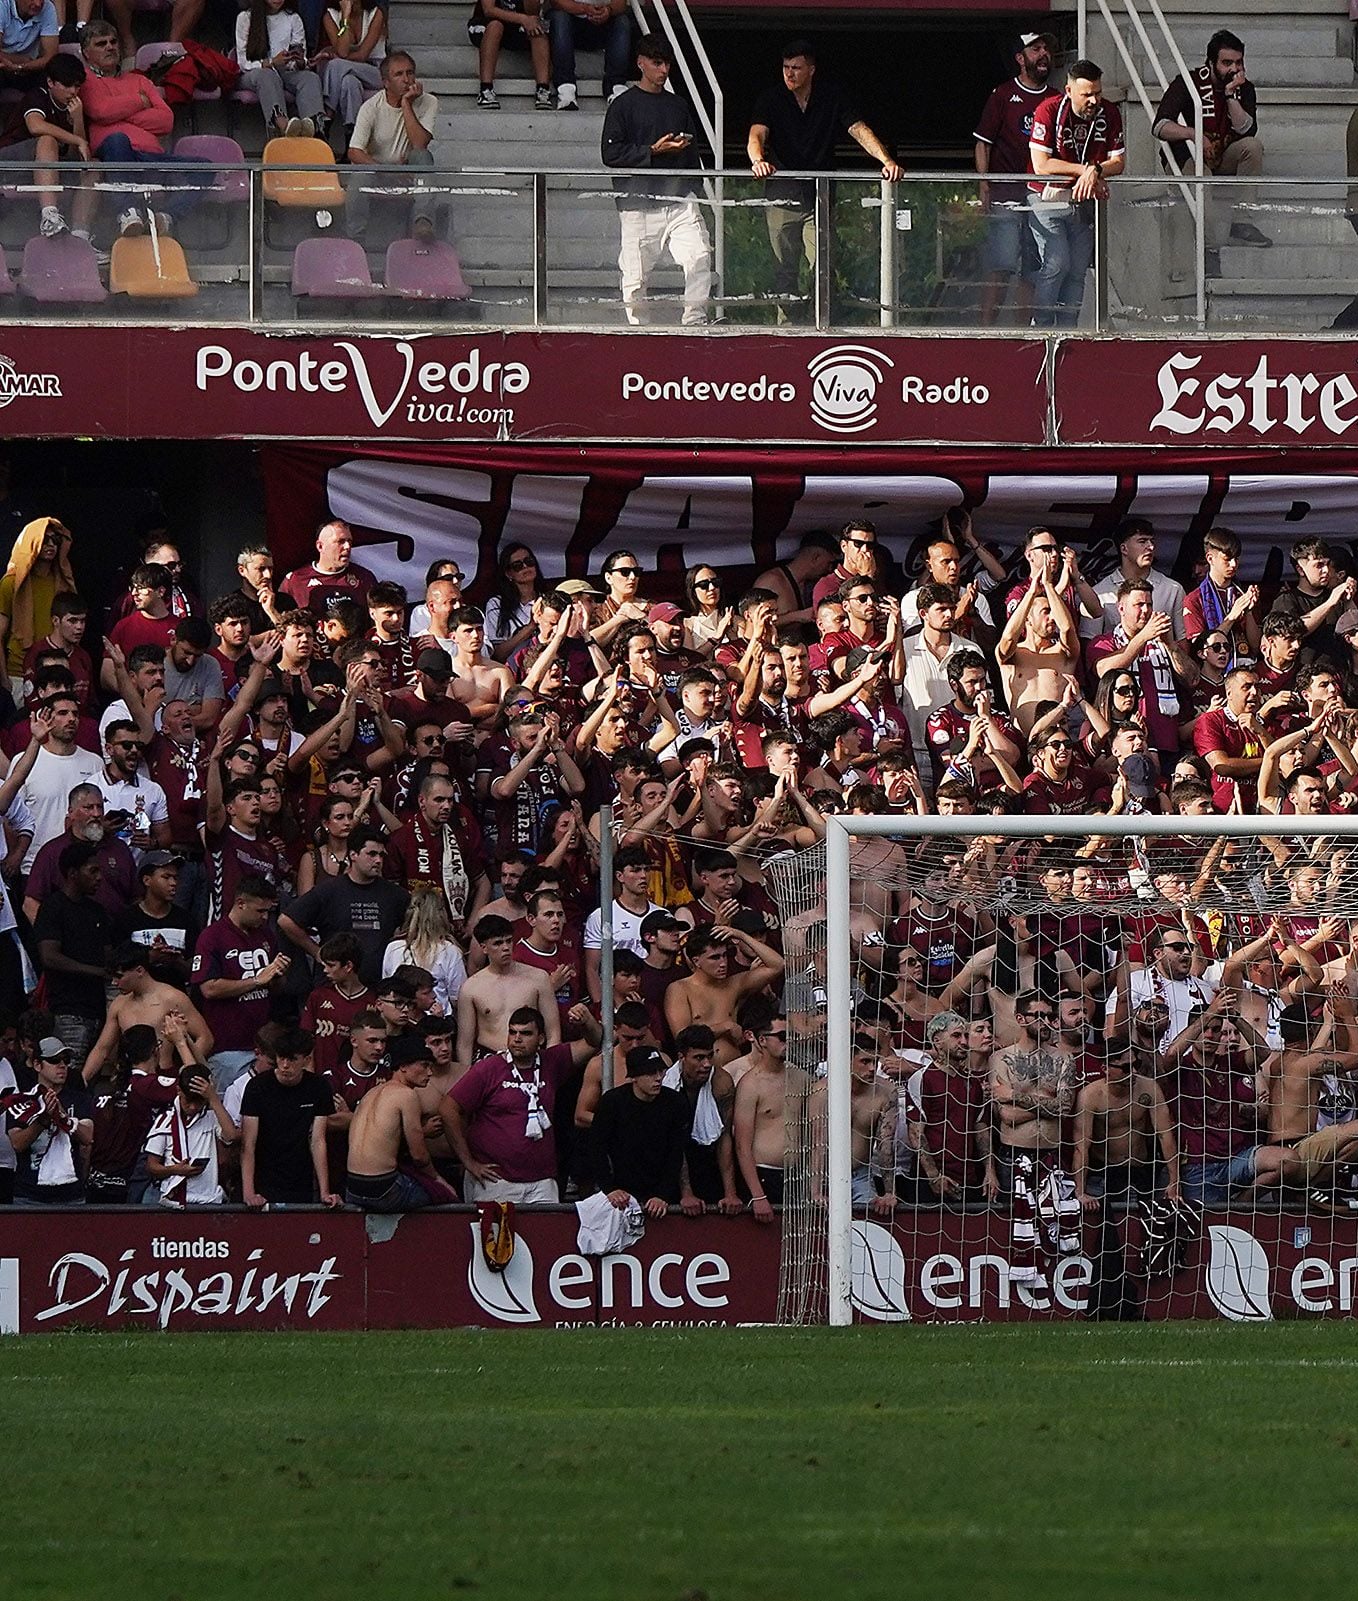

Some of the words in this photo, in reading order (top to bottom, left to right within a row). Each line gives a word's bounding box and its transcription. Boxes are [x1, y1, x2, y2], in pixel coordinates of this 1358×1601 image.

[622, 372, 796, 402] Pontevedra
[816, 374, 877, 405] Viva
[901, 376, 990, 405] Radio
[151, 1236, 230, 1259] tiendas
[34, 1247, 344, 1329] Dispaint
[548, 1251, 730, 1309] ence
